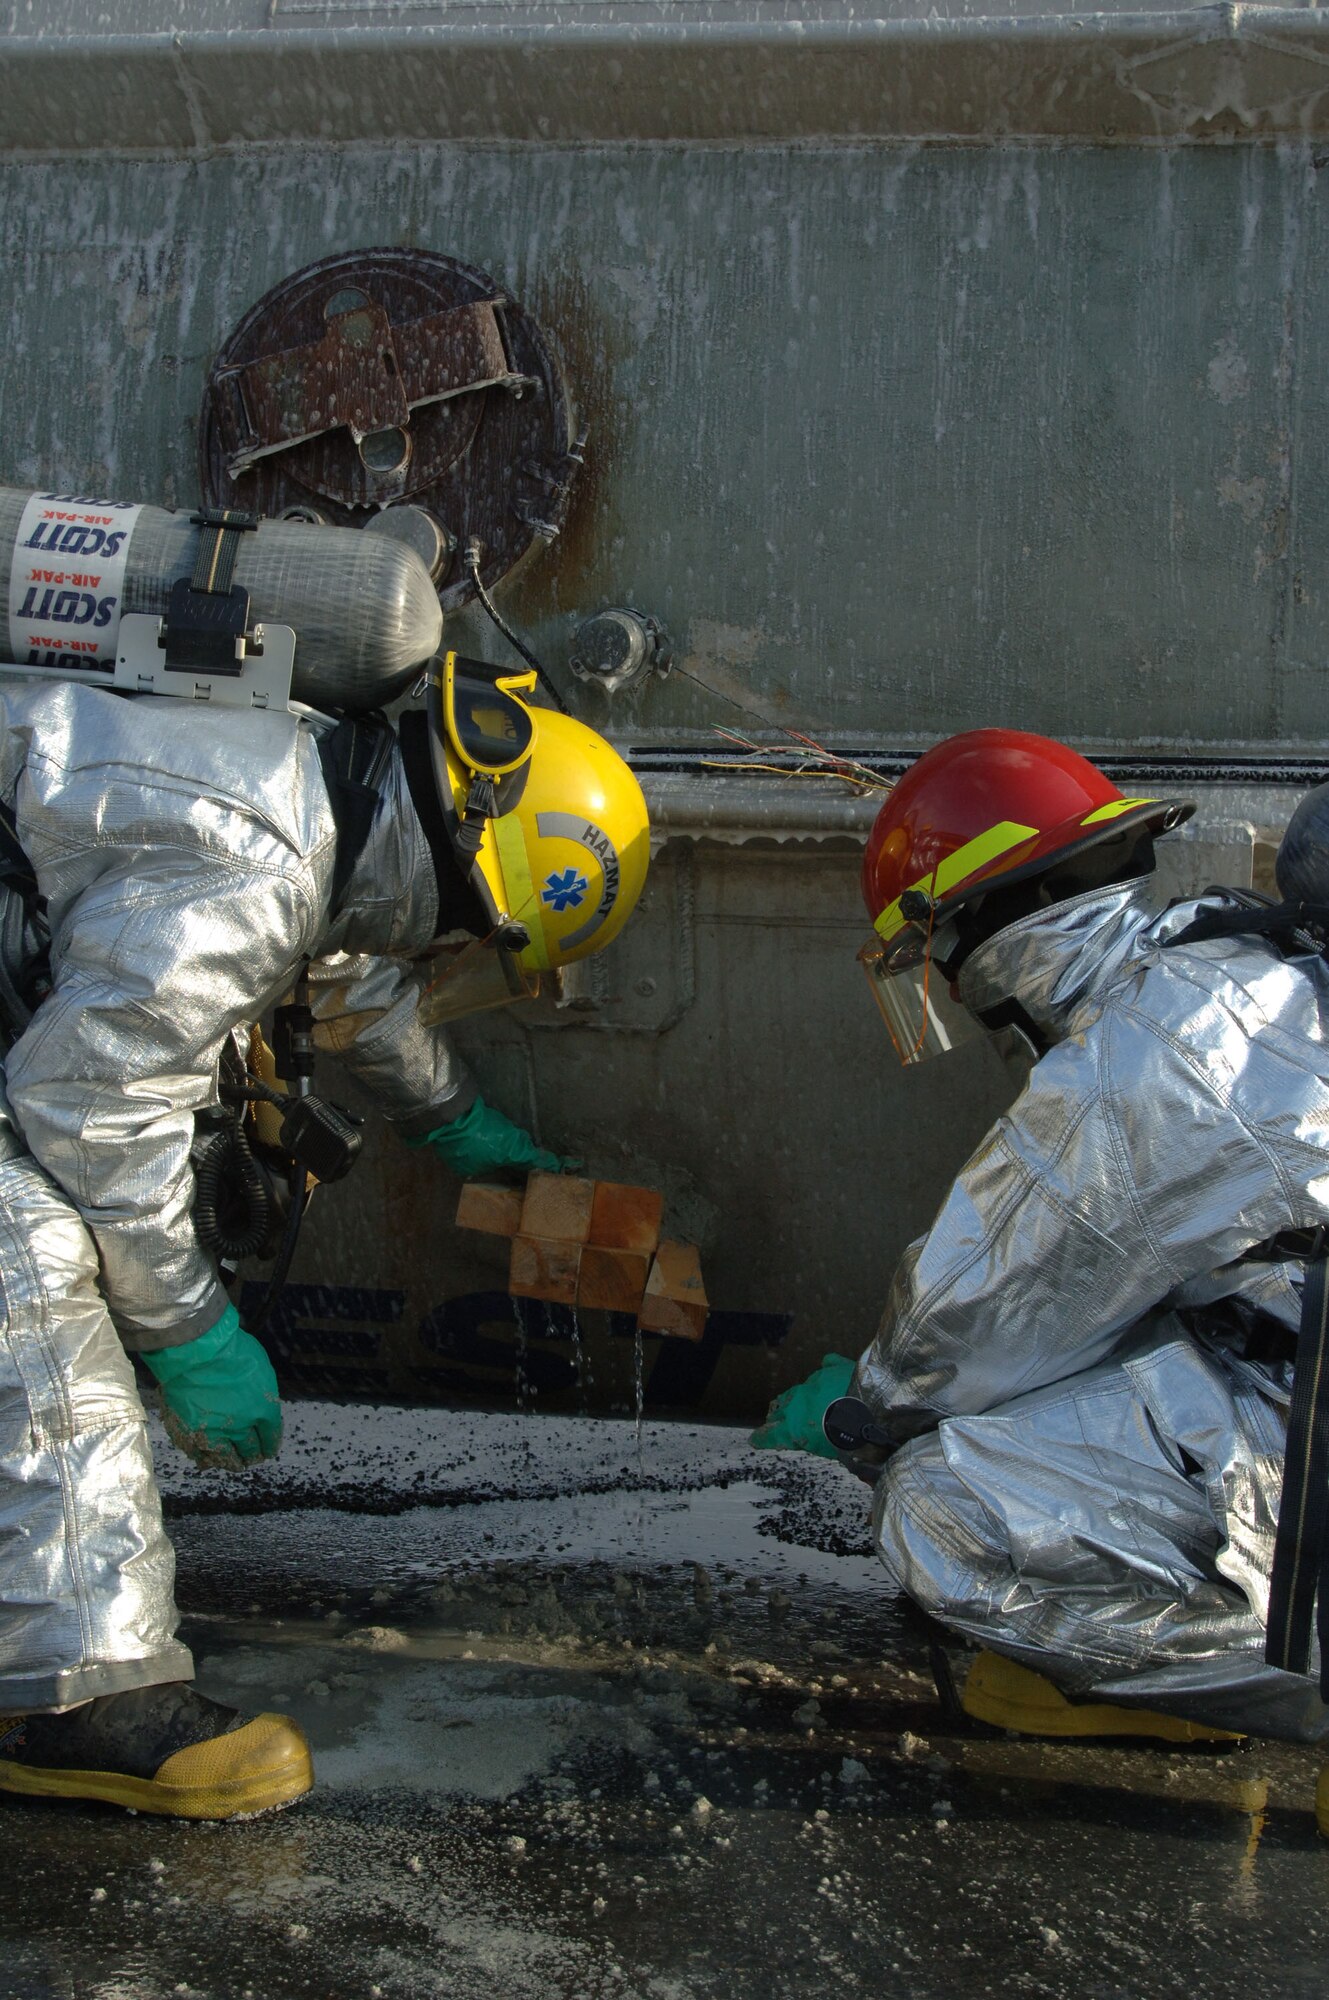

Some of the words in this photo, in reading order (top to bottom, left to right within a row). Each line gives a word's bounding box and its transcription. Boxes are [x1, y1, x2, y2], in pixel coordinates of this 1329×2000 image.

[43, 510, 113, 525] AIR-PAK
[23, 522, 127, 557] SCOTT
[31, 568, 101, 587] AIR-PAK
[17, 587, 116, 626] SCOTT
[29, 636, 98, 652] AIR-PAK
[582, 825, 619, 918] HAZMAT
